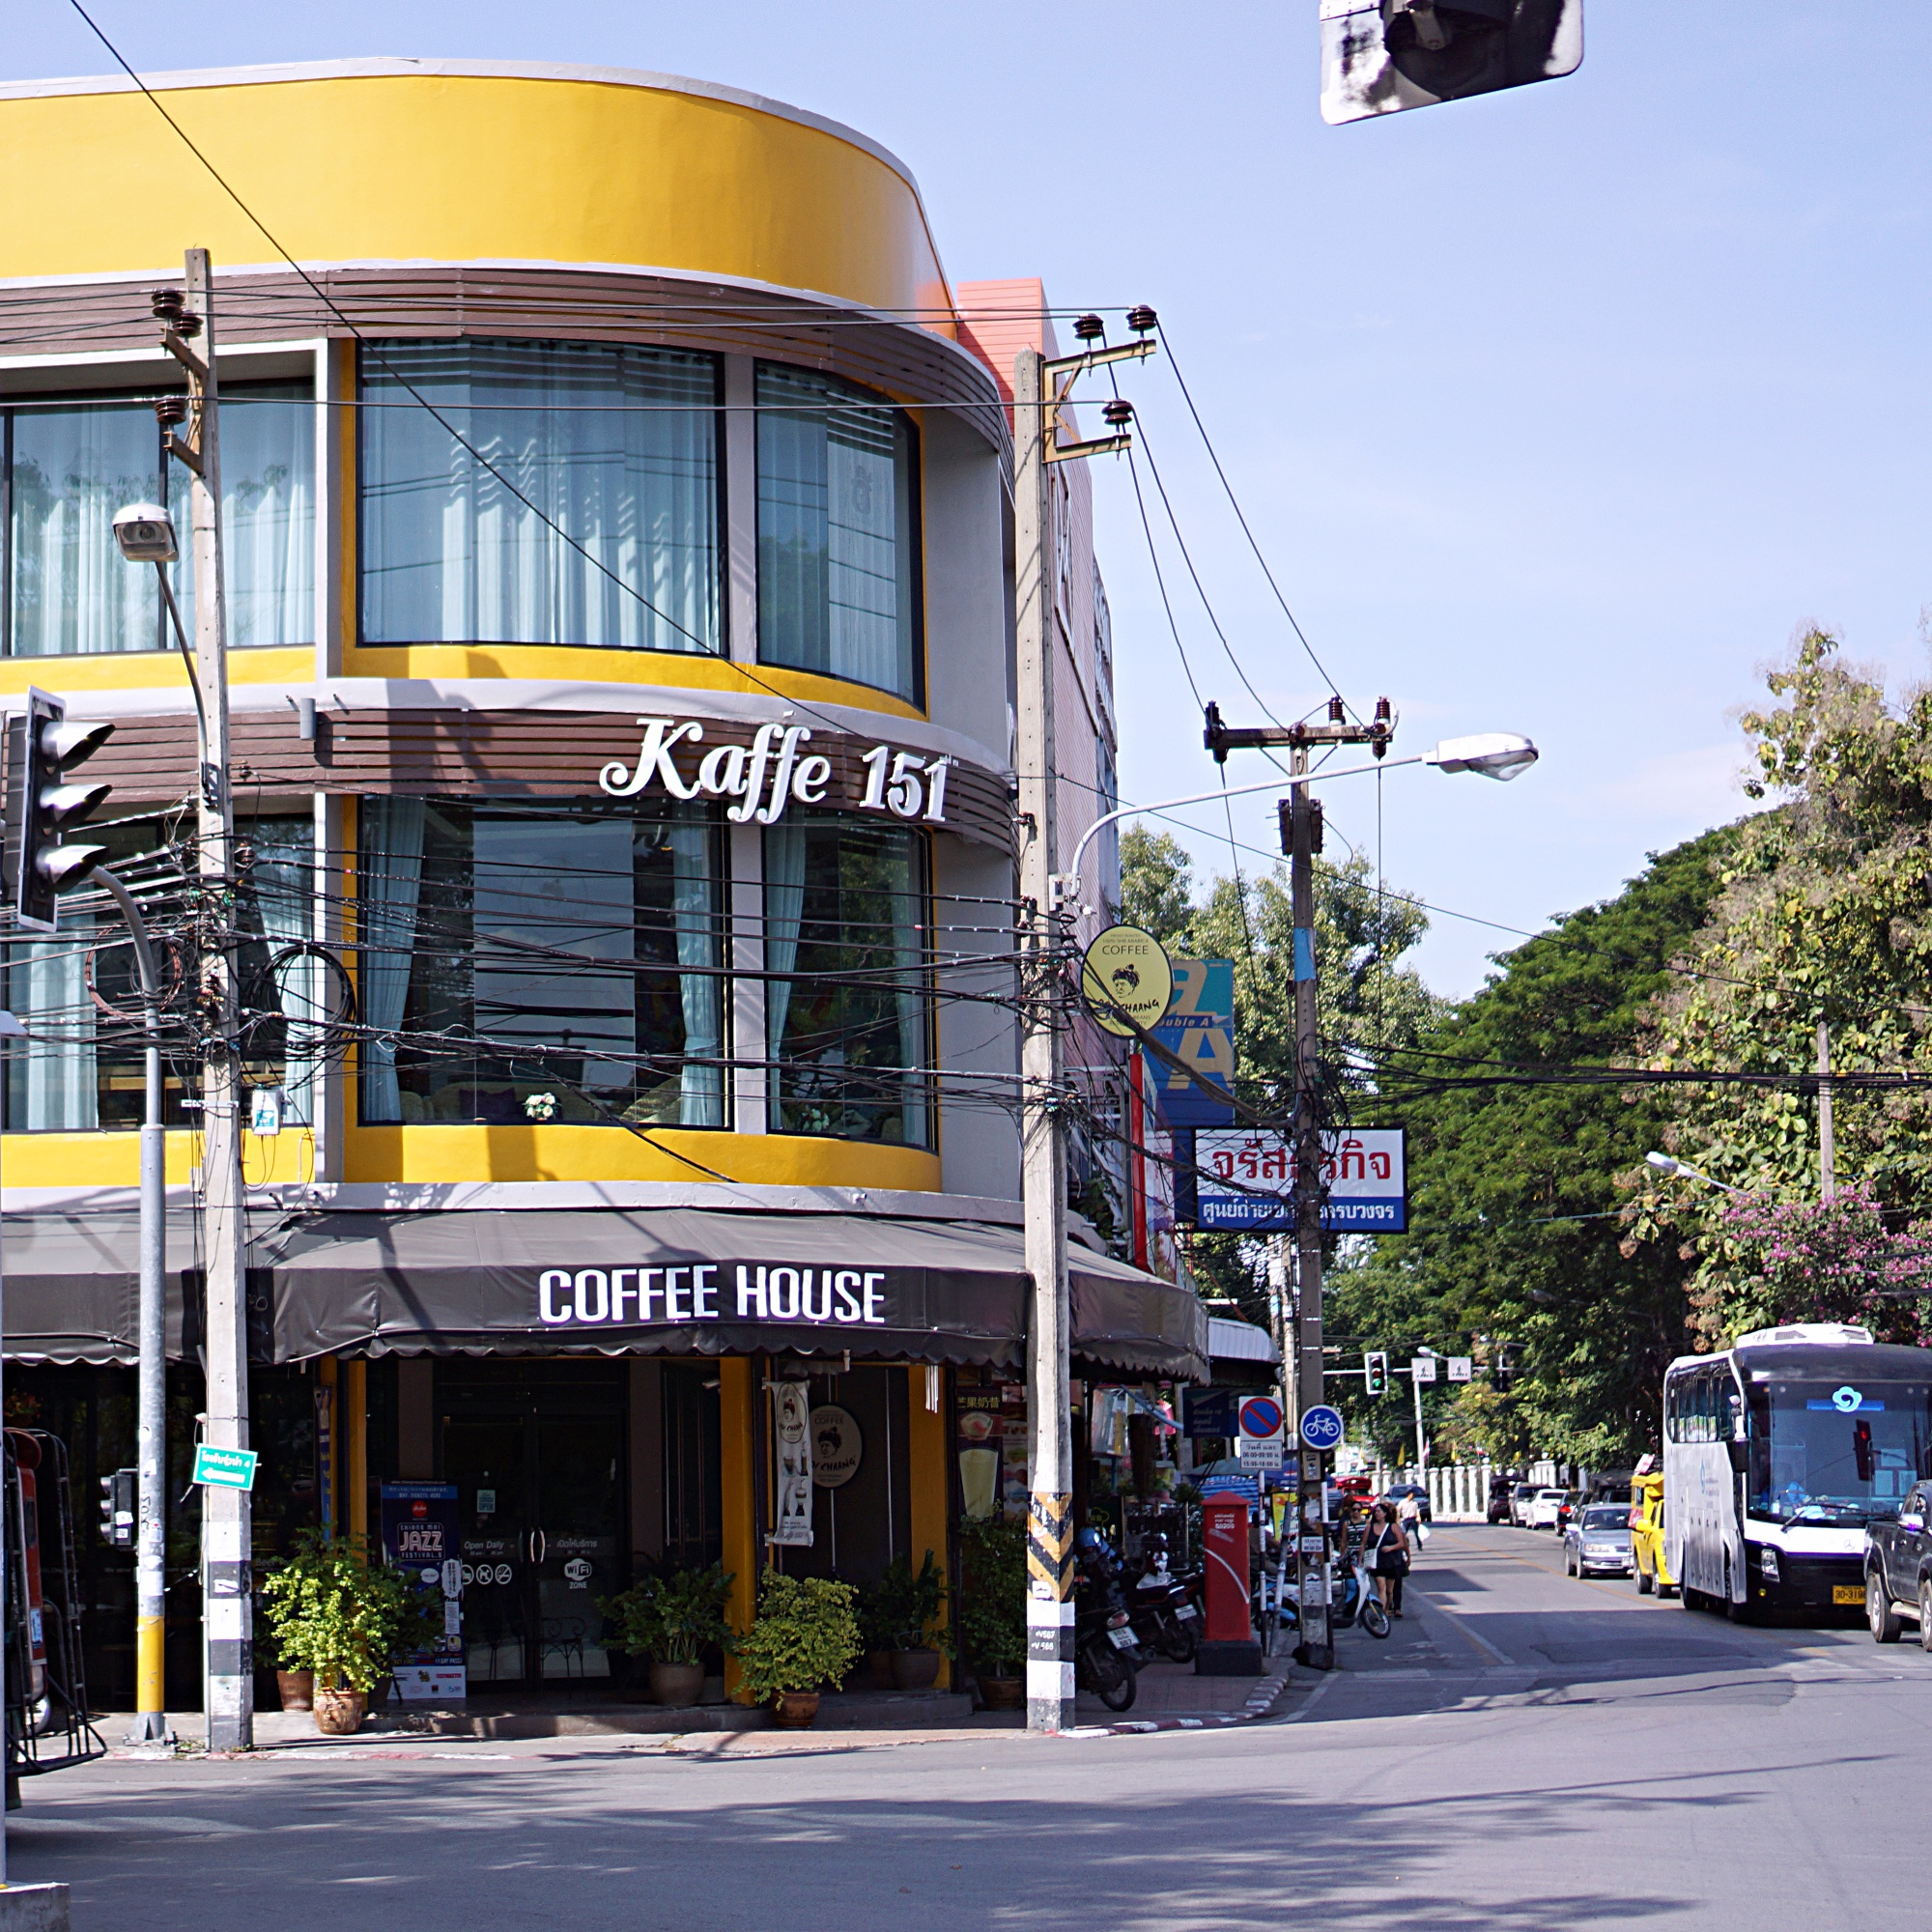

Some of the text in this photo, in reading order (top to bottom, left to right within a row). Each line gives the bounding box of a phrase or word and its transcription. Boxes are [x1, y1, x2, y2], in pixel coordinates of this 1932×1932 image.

[599, 718, 949, 824] Kaffe 151
[1101, 945, 1149, 955] COFFEE
[1200, 1017, 1209, 1027] A
[539, 1264, 886, 1323] COFFEE HOUSE
[957, 1397, 1000, 1408] 芒果奶昔
[399, 1531, 443, 1551] JAZZ
[464, 1540, 504, 1550] Open Daily
[569, 1581, 587, 1590] ZONE
